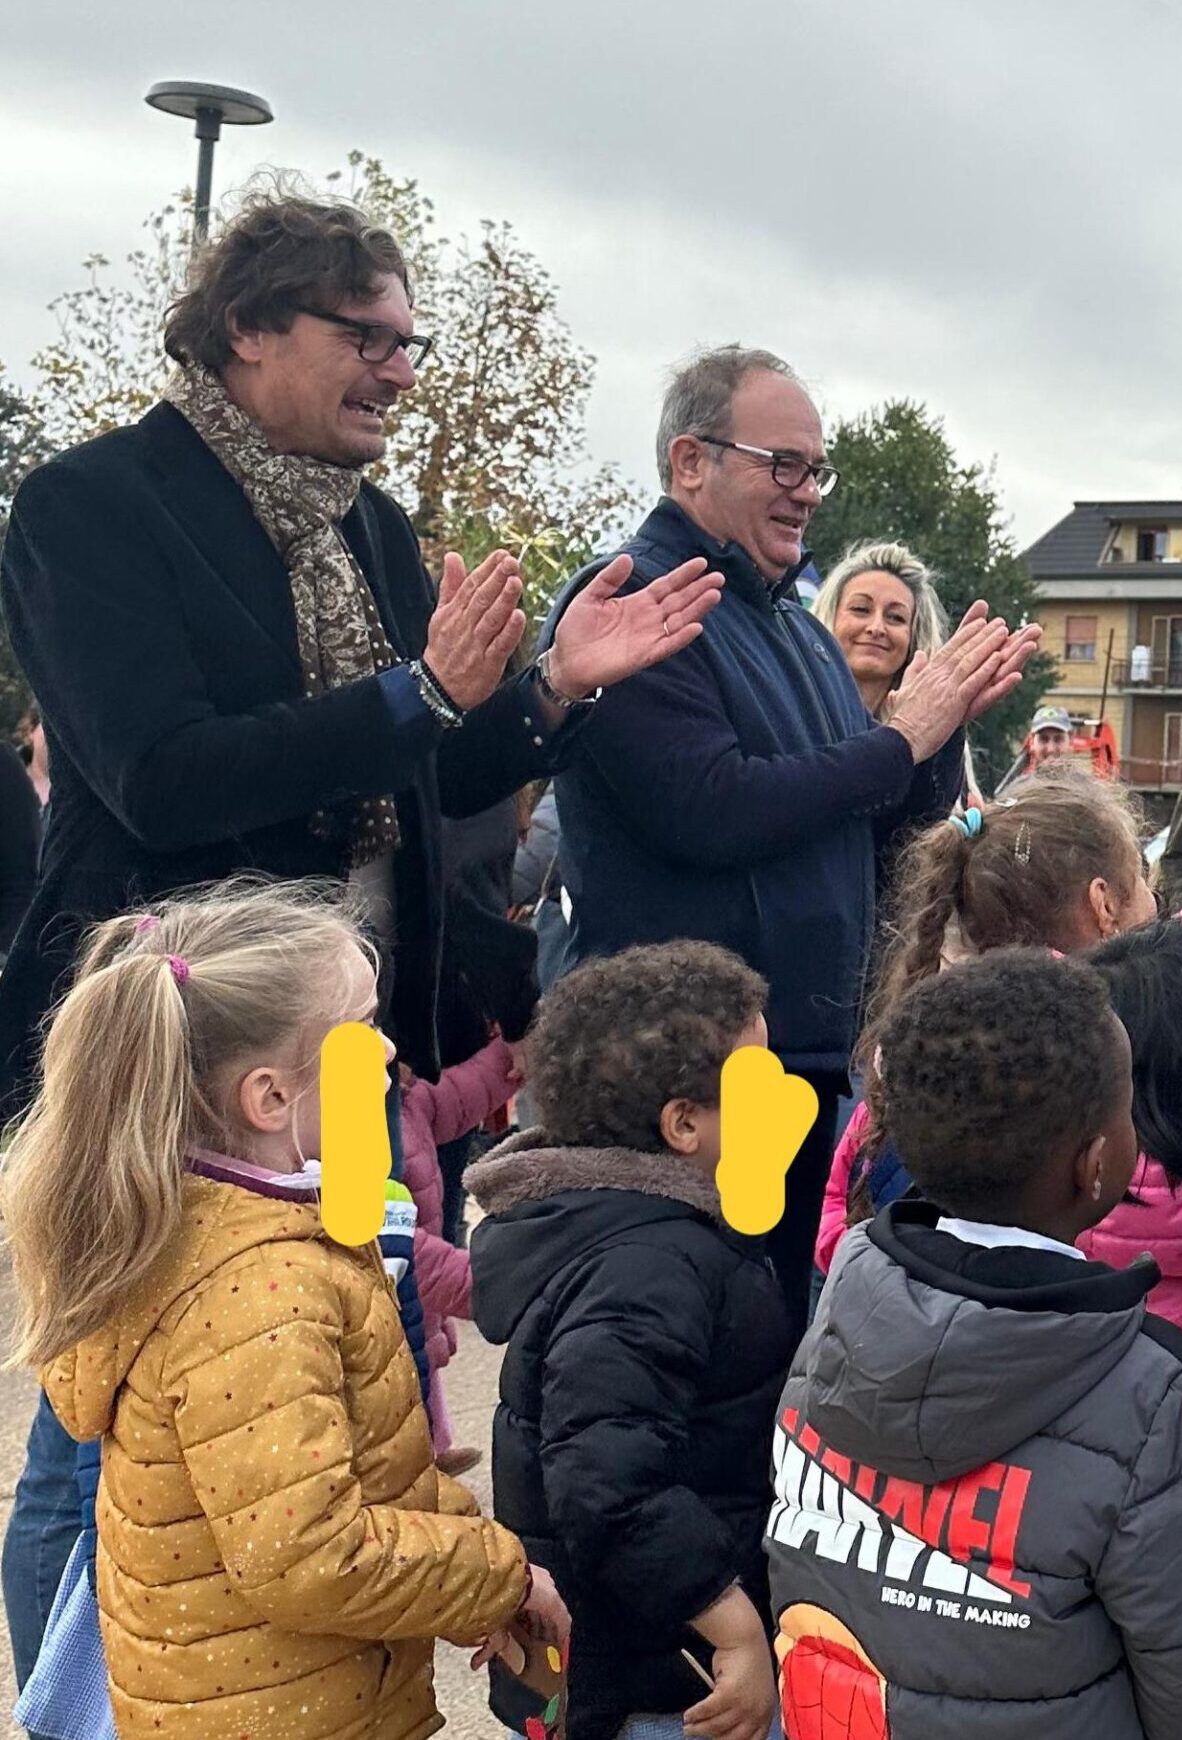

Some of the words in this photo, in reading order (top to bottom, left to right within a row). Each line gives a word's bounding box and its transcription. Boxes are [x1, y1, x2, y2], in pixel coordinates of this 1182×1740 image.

[881, 1586, 916, 1608] HERO
[917, 1595, 932, 1612] IN
[935, 1599, 961, 1619] THE
[964, 1605, 1031, 1629] MAKING
